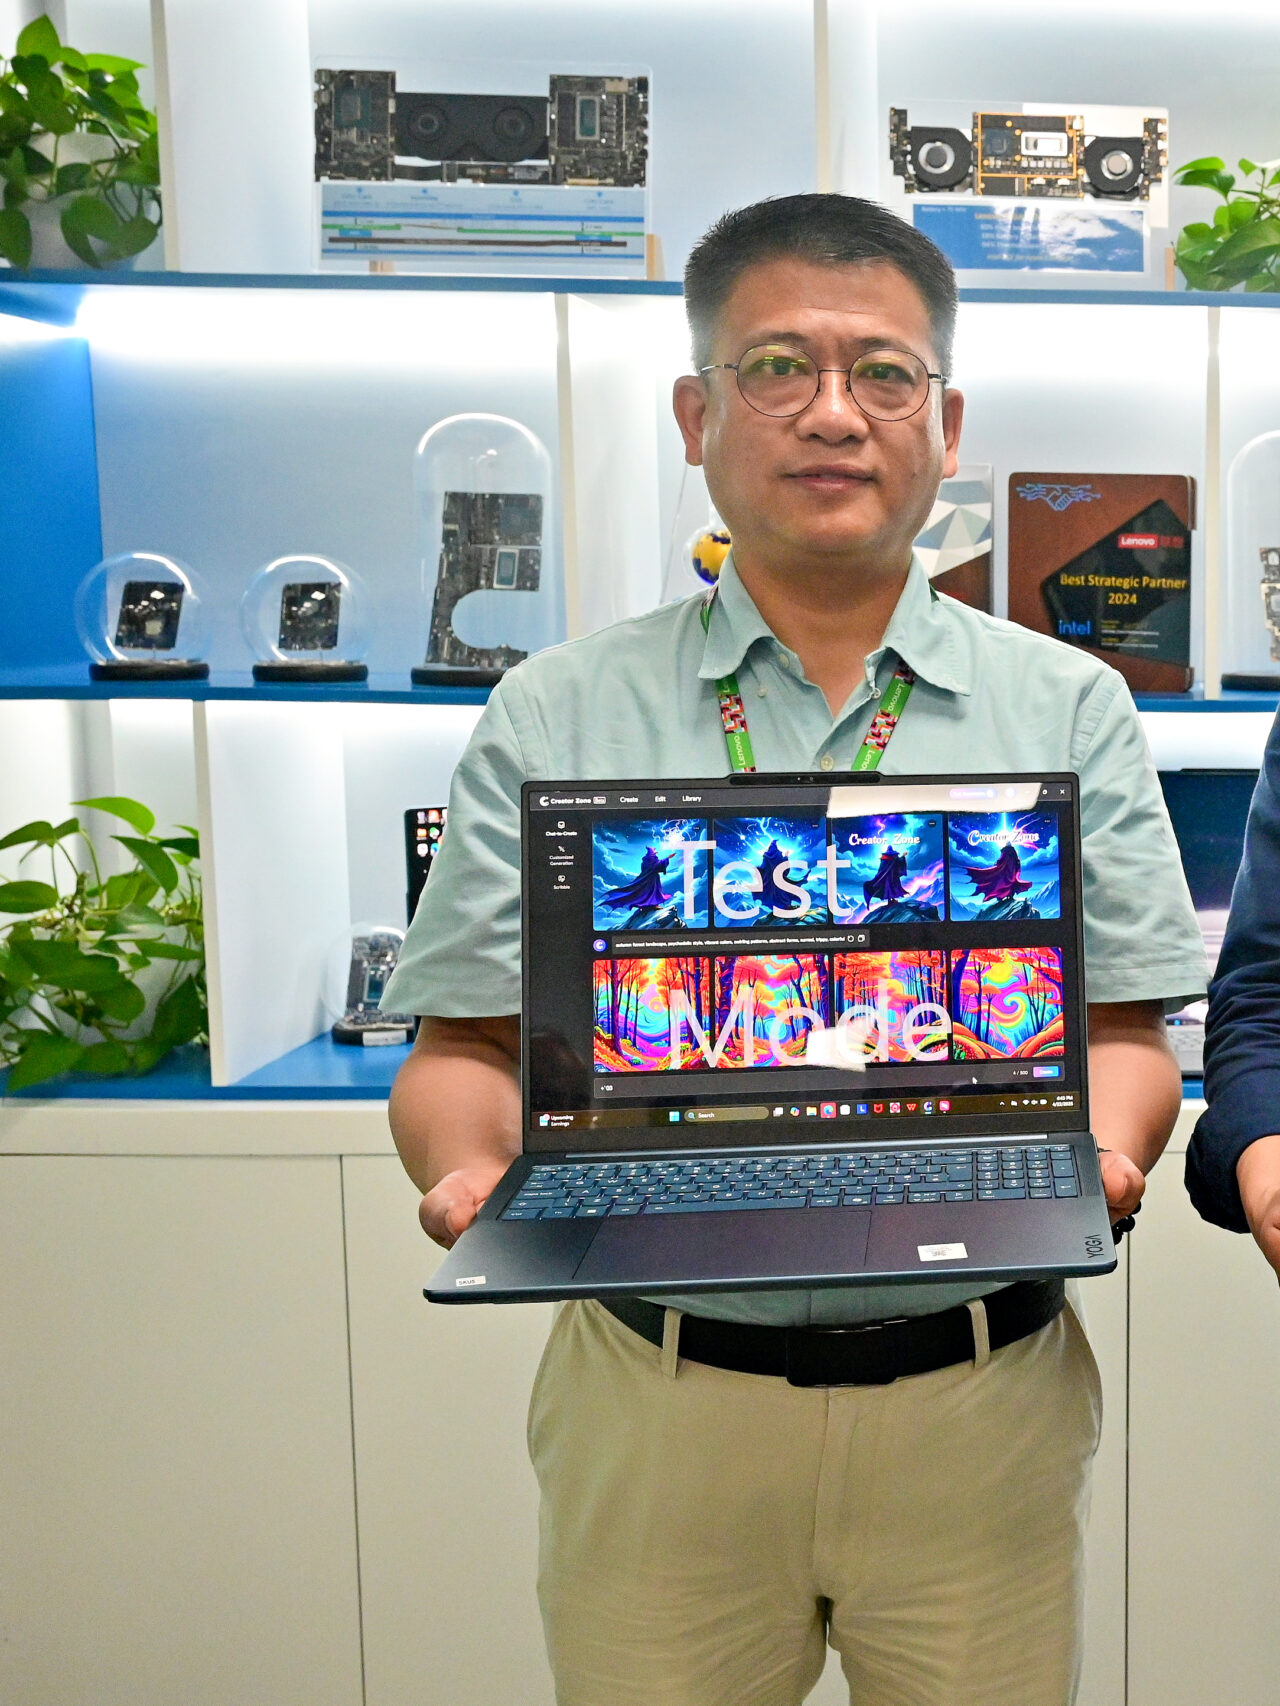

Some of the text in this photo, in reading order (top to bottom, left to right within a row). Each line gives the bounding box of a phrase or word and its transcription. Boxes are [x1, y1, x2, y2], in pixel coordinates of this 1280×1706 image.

[1120, 536, 1155, 546] Lenovo
[1060, 573, 1187, 590] Best Strategic Partner
[1108, 592, 1138, 605] 2024
[1058, 620, 1091, 635] intel
[888, 683, 906, 712] Lenovo
[734, 735, 746, 766] Lenovo
[848, 834, 920, 846] Creator Zone
[967, 830, 1040, 846] Creator Zone
[661, 840, 852, 920] Test
[670, 978, 953, 1070] Mode
[1084, 1234, 1104, 1259] YOGA
